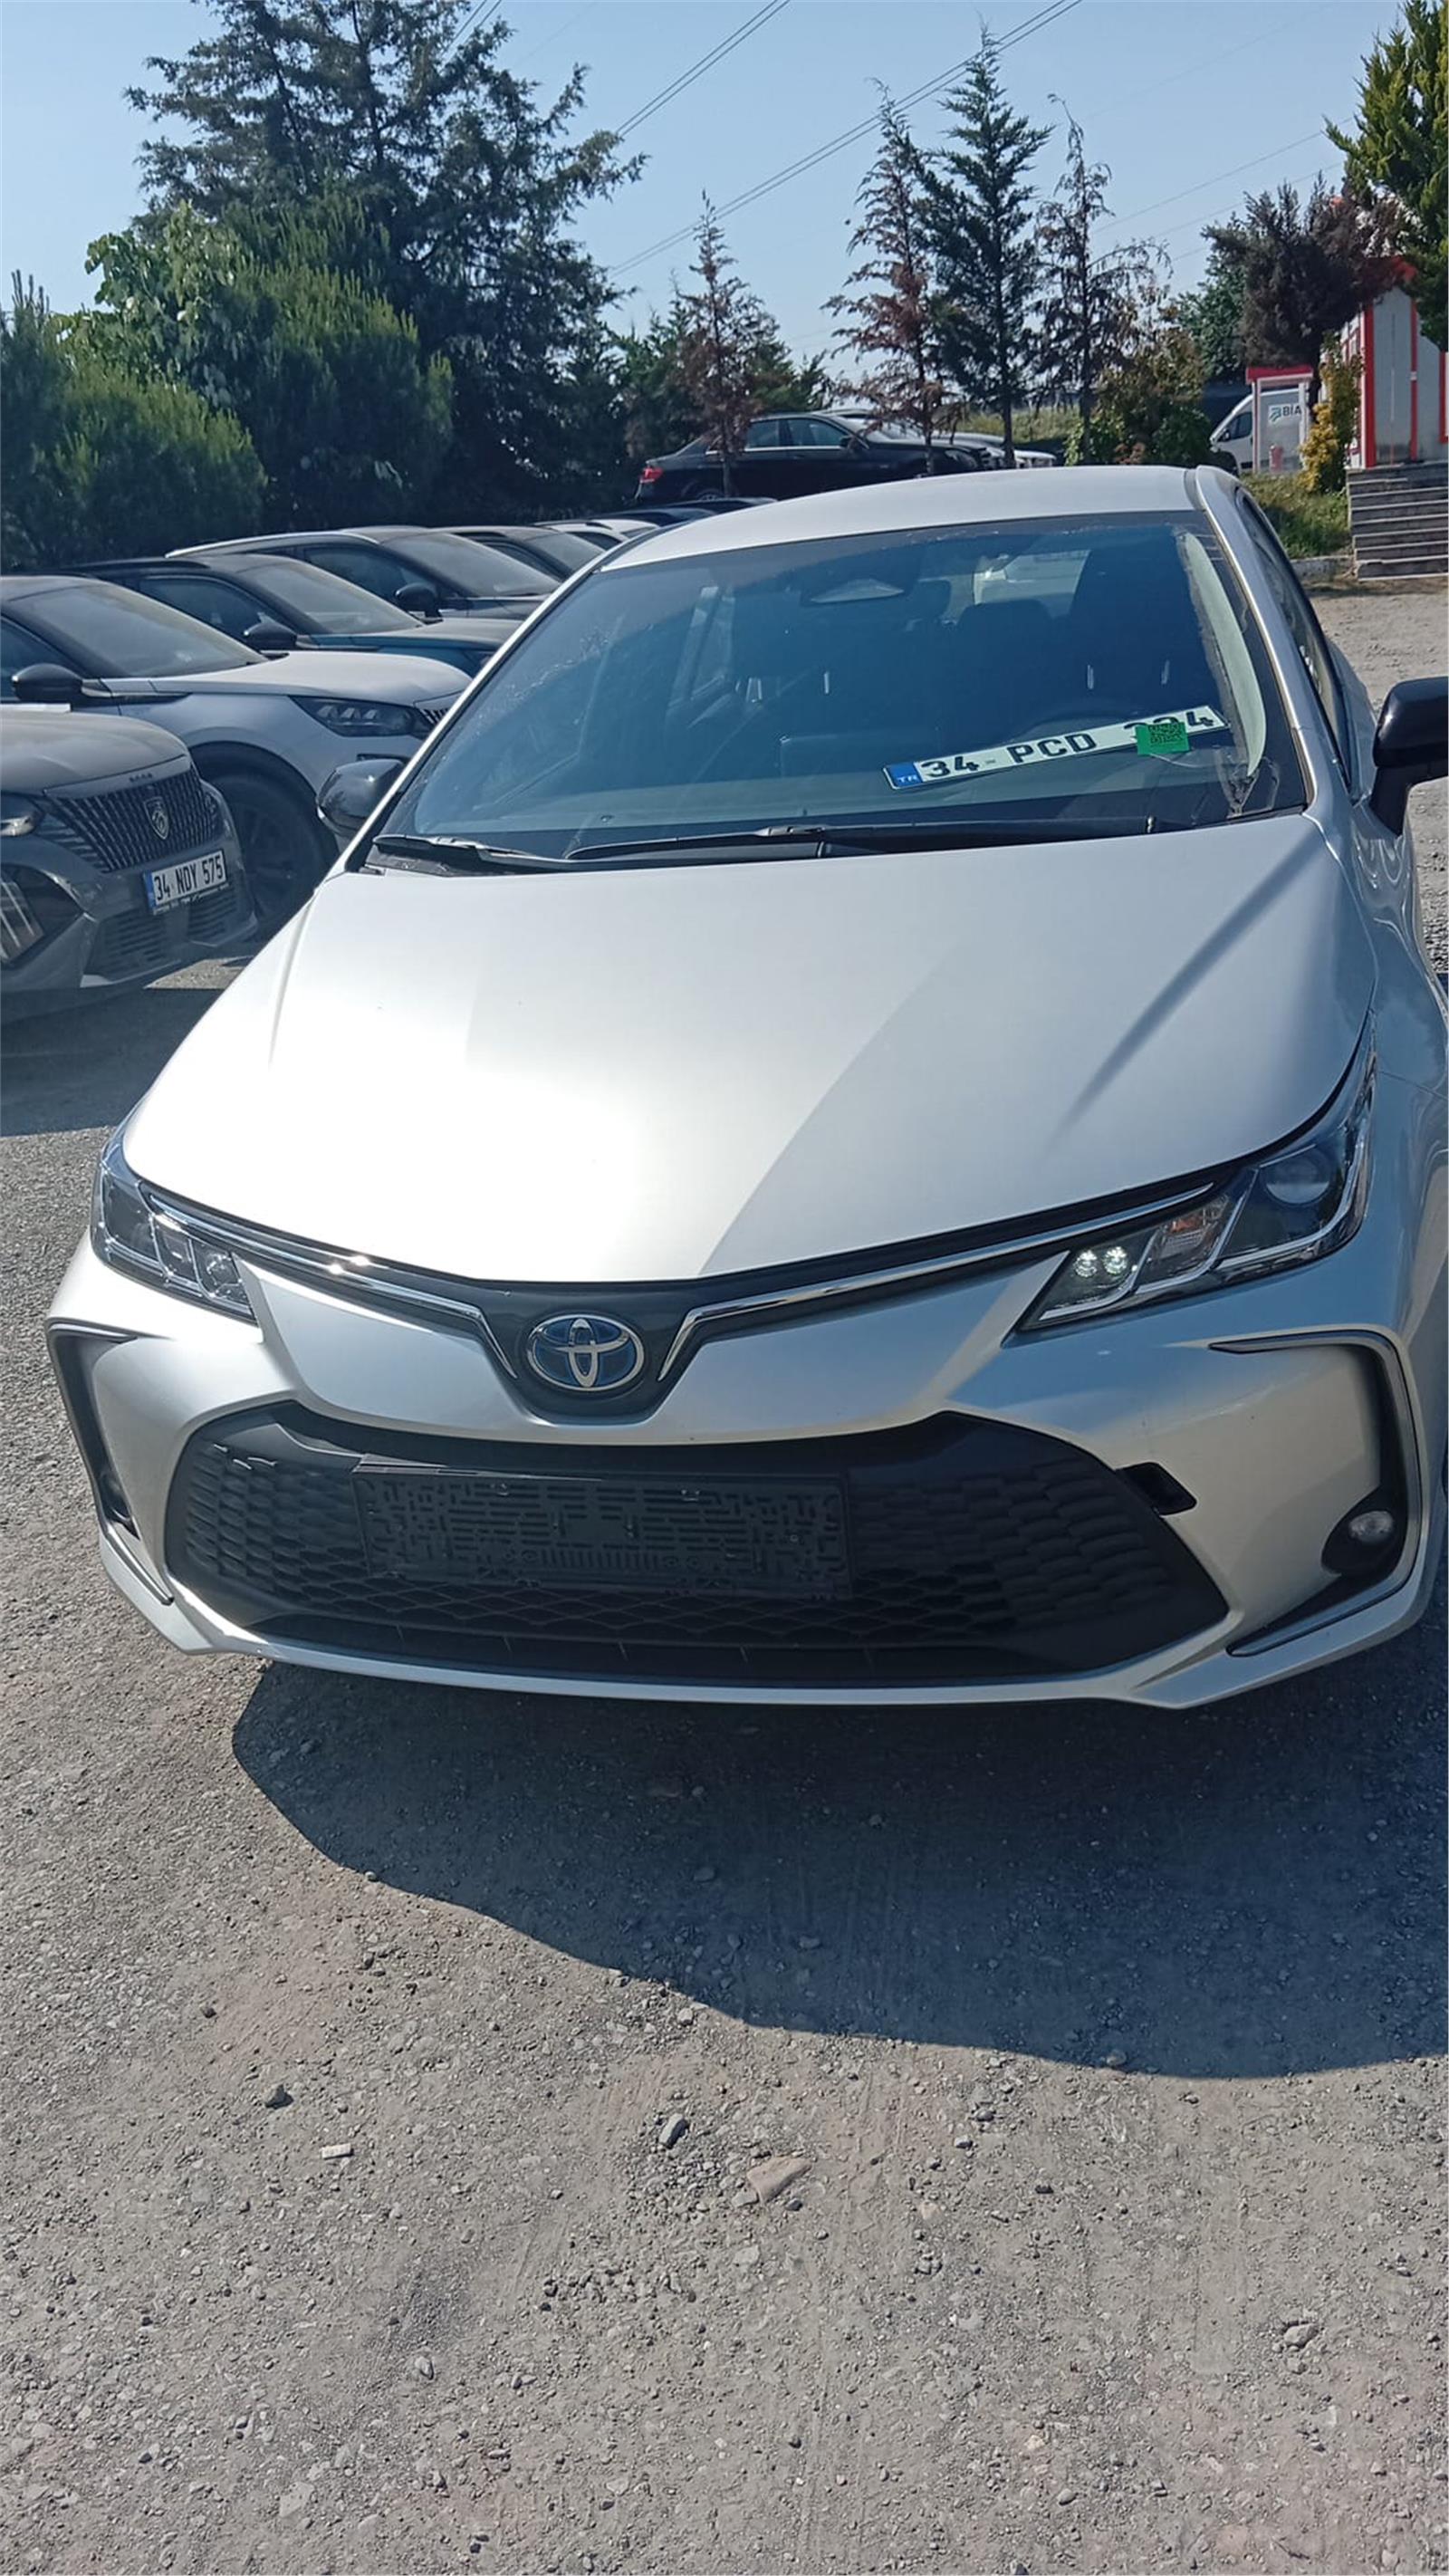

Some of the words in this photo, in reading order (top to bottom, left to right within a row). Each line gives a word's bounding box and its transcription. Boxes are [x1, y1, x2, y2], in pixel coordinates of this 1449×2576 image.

[921, 756, 979, 778] 34
[1006, 733, 1098, 764] PCD
[897, 775, 918, 783] TR
[154, 873, 171, 901] 34
[175, 862, 197, 895] NDY
[202, 854, 224, 885] 575
